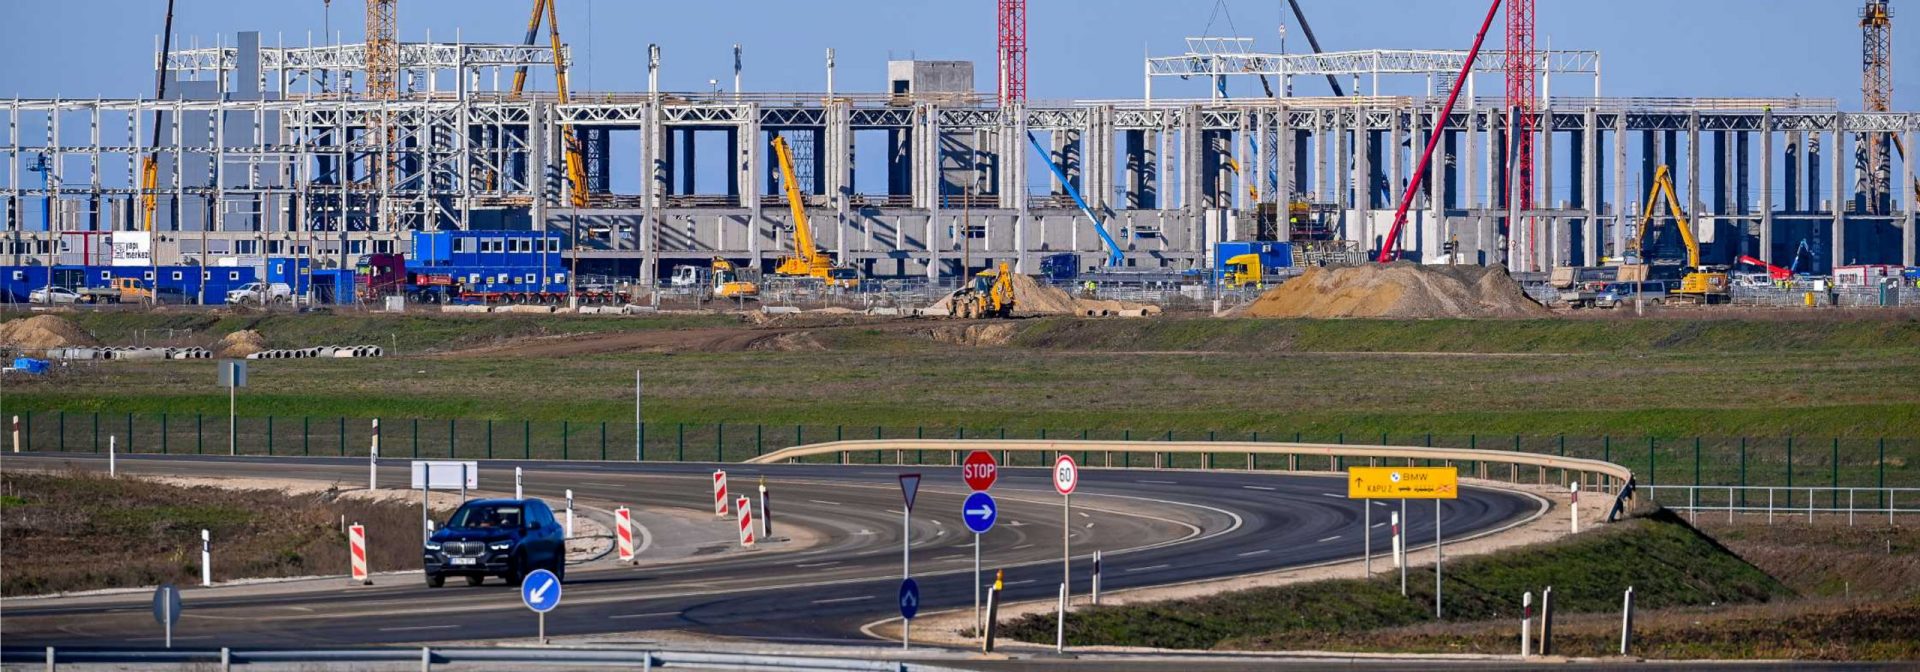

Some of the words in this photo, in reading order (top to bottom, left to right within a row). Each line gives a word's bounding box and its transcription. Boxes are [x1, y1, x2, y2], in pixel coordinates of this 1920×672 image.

[965, 463, 995, 478] STOP
[1060, 468, 1071, 482] 60
[1403, 472, 1428, 481] BMW
[1367, 484, 1387, 493] KAPU
